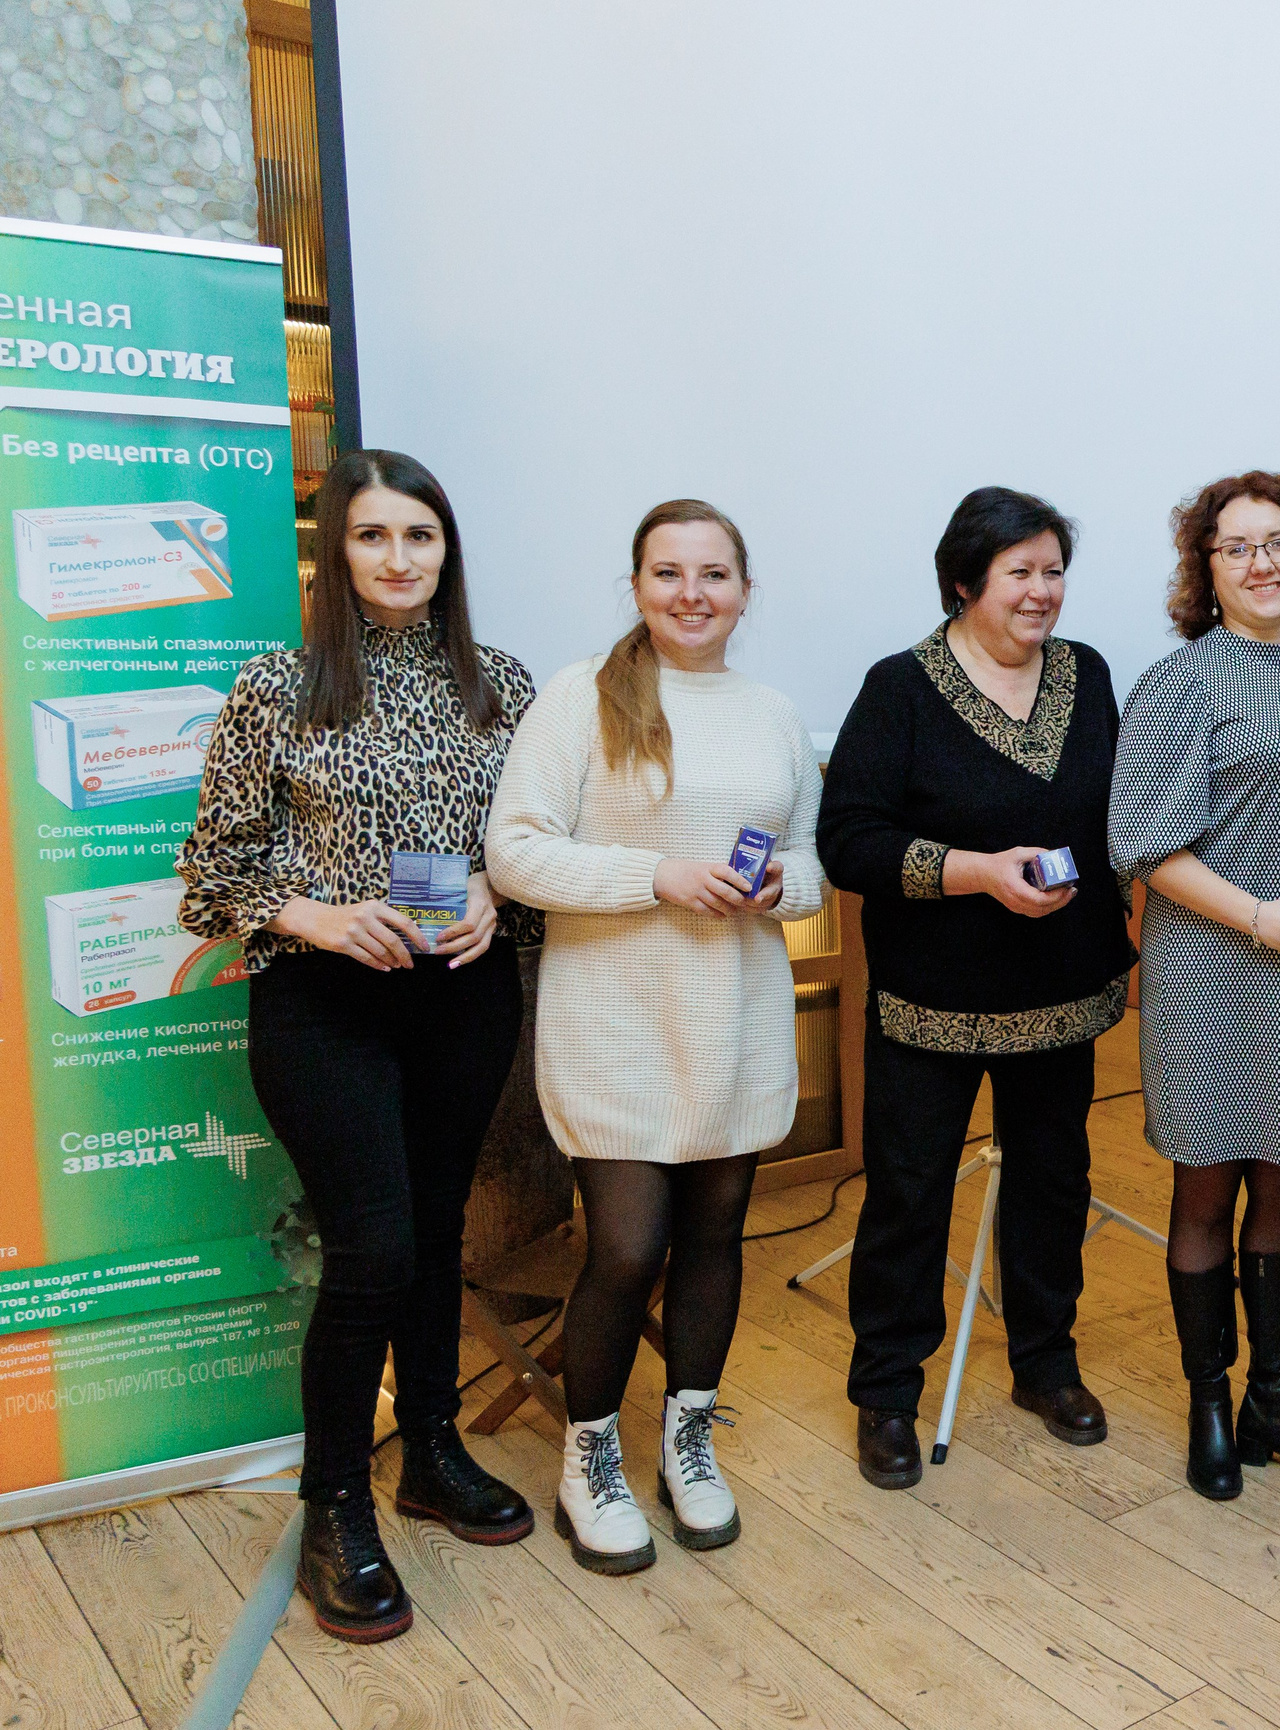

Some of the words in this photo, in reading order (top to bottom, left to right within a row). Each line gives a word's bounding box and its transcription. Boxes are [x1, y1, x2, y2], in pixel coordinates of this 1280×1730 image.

[0, 337, 236, 384] ЕРОЛОГИЯ
[2, 434, 59, 458] Без
[68, 442, 190, 466] рецепта
[50, 576, 98, 585] Гимекромон
[51, 591, 64, 600] 50
[67, 588, 107, 597] таблеток
[121, 582, 141, 592] 200
[23, 635, 158, 650] Селективный
[164, 639, 286, 650] спазмолитик
[25, 660, 36, 671] с
[42, 660, 178, 672] желчегонным
[84, 764, 124, 773] Мебеверин
[86, 780, 98, 788] 50
[149, 769, 166, 778] 135
[38, 819, 165, 838] Селективный
[39, 847, 76, 862] при
[81, 843, 128, 857] боли
[133, 845, 145, 854] и
[81, 947, 136, 962] Рабепразол
[222, 968, 236, 979] 10
[82, 981, 102, 995] 10
[109, 977, 131, 989] мг
[105, 994, 132, 1005] капсул
[51, 1026, 149, 1047] Снижение
[53, 1047, 141, 1068] желудка,
[146, 1040, 222, 1059] лечение
[60, 1122, 199, 1153] Северная
[62, 1145, 177, 1174] ЗВЕЗДА
[34, 1272, 89, 1286] входят
[93, 1270, 102, 1278] в
[105, 1254, 200, 1277] клинические
[43, 1274, 161, 1302] заболеваниями
[164, 1266, 222, 1284] органов
[64, 1317, 181, 1344] гастроэнтерологов
[183, 1310, 226, 1324] России
[228, 1302, 267, 1317] (НОГР)
[52, 1336, 136, 1359] пищеварения
[139, 1335, 146, 1343] в
[149, 1327, 192, 1343] период
[195, 1319, 253, 1335] пандемии
[54, 1345, 173, 1372] гастроэнтерология,
[176, 1335, 219, 1350] выпуск
[248, 1327, 261, 1337] №
[264, 1327, 271, 1335] 3
[274, 1320, 300, 1333] 2020
[5, 1366, 186, 1418] ПРОКОНСУЛЬТИРУЙТЕСЬ
[189, 1362, 209, 1384] СО
[212, 1345, 303, 1380] СПЕЦИАЛИСТ
